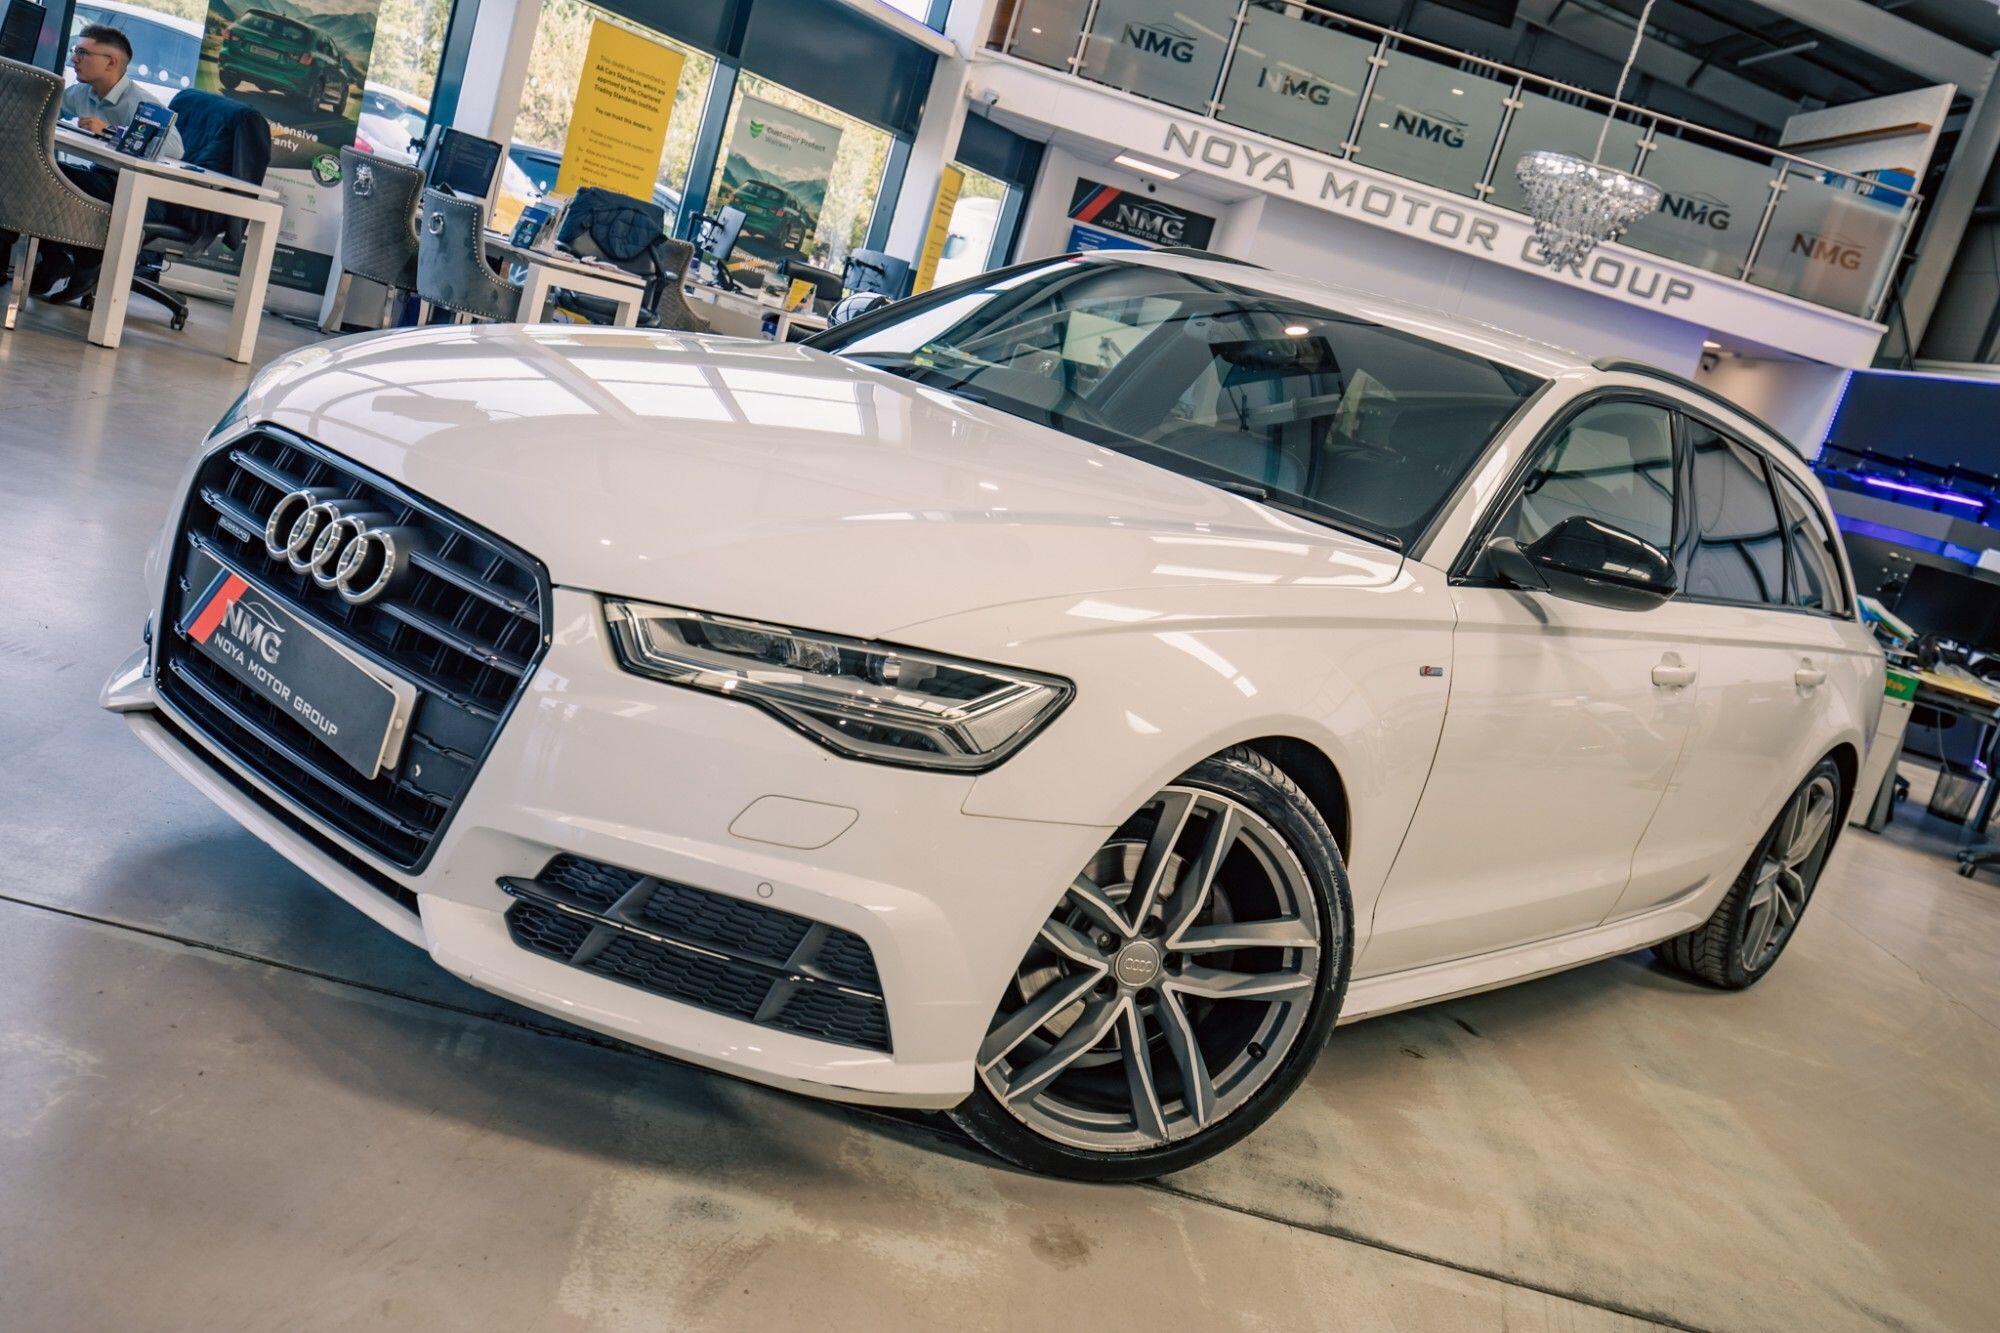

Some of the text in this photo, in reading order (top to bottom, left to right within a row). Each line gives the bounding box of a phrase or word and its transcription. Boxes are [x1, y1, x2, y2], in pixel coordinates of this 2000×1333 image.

[1121, 23, 1195, 64] NMG
[1257, 67, 1331, 106] NMG
[1393, 110, 1465, 148] NMG
[1163, 123, 1294, 190] NOYA
[1320, 171, 1500, 251] MOTOR
[1116, 203, 1185, 240] NMG
[1659, 192, 1731, 231] NMG
[1128, 227, 1159, 241] MOTOR
[1790, 232, 1863, 271] NMG
[220, 598, 282, 664] NMG
[214, 632, 338, 737] NOYA MOTOR GROUP
